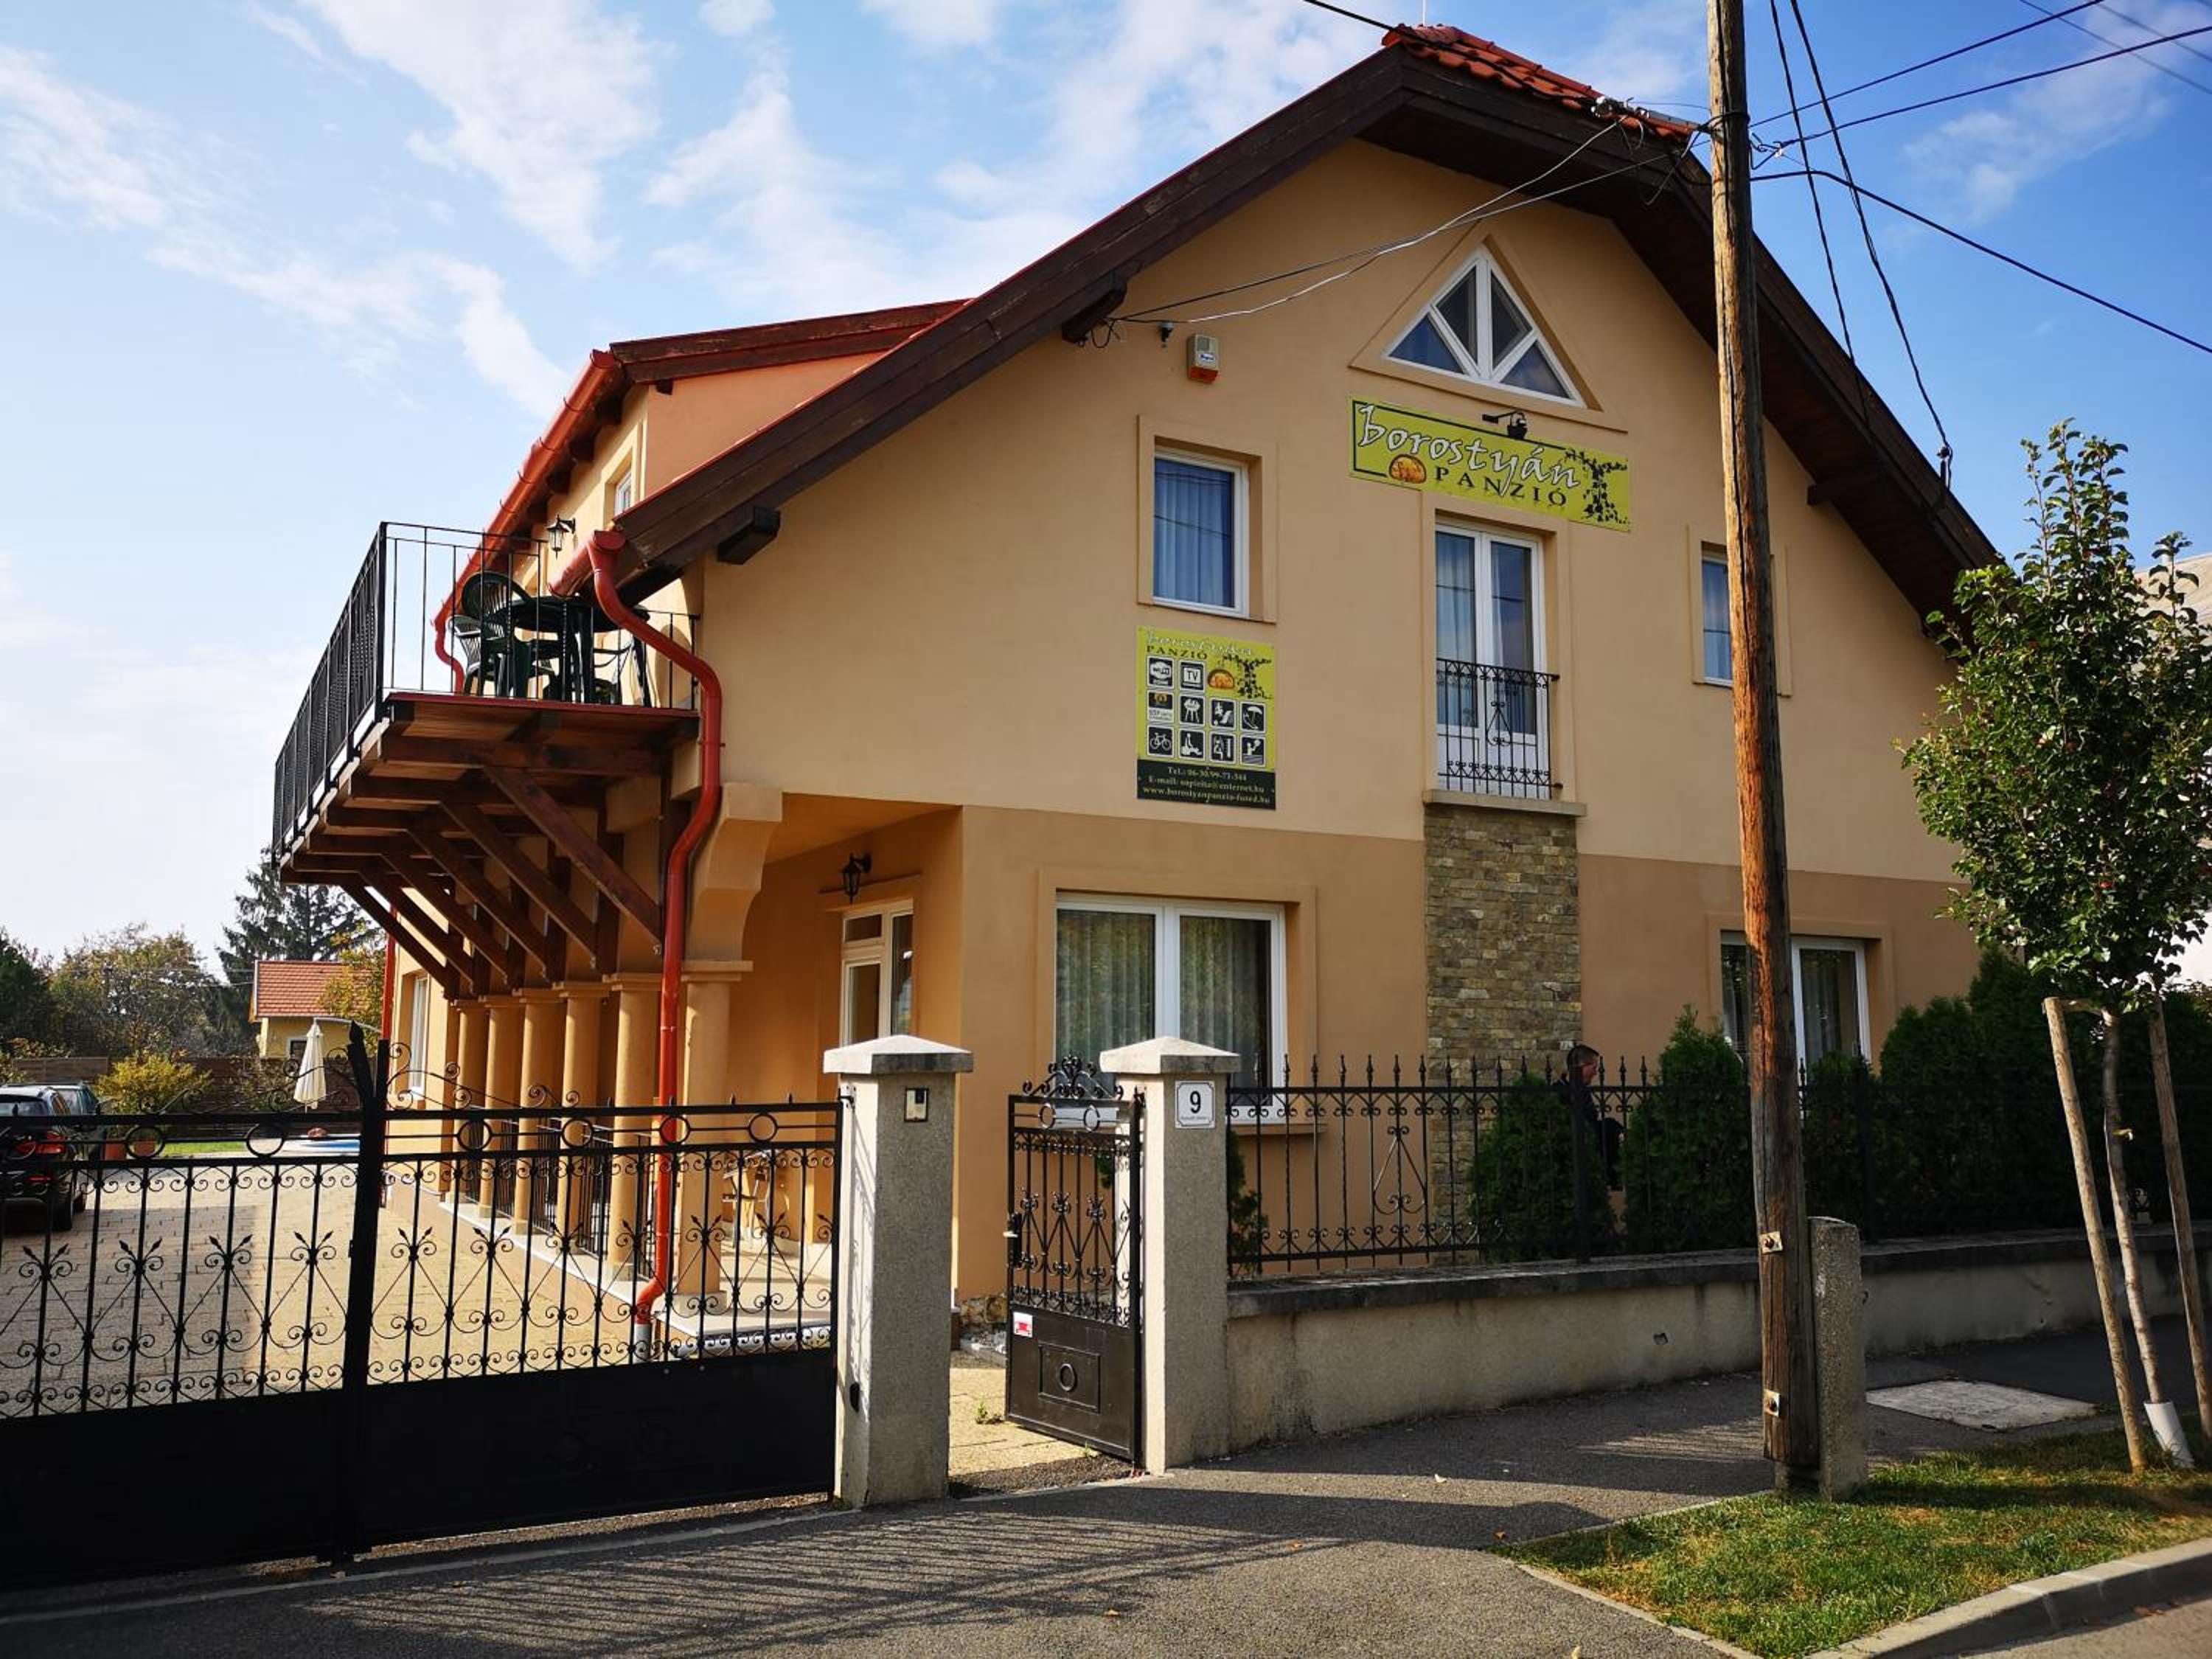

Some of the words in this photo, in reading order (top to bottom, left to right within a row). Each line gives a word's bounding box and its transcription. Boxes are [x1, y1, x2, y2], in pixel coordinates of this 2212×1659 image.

[1358, 404, 1582, 497] borostyán
[1434, 465, 1568, 508] PANZIÓ
[1146, 645, 1208, 659] PANZIÓ
[1186, 670, 1198, 681] TV
[1189, 1090, 1201, 1114] 9
